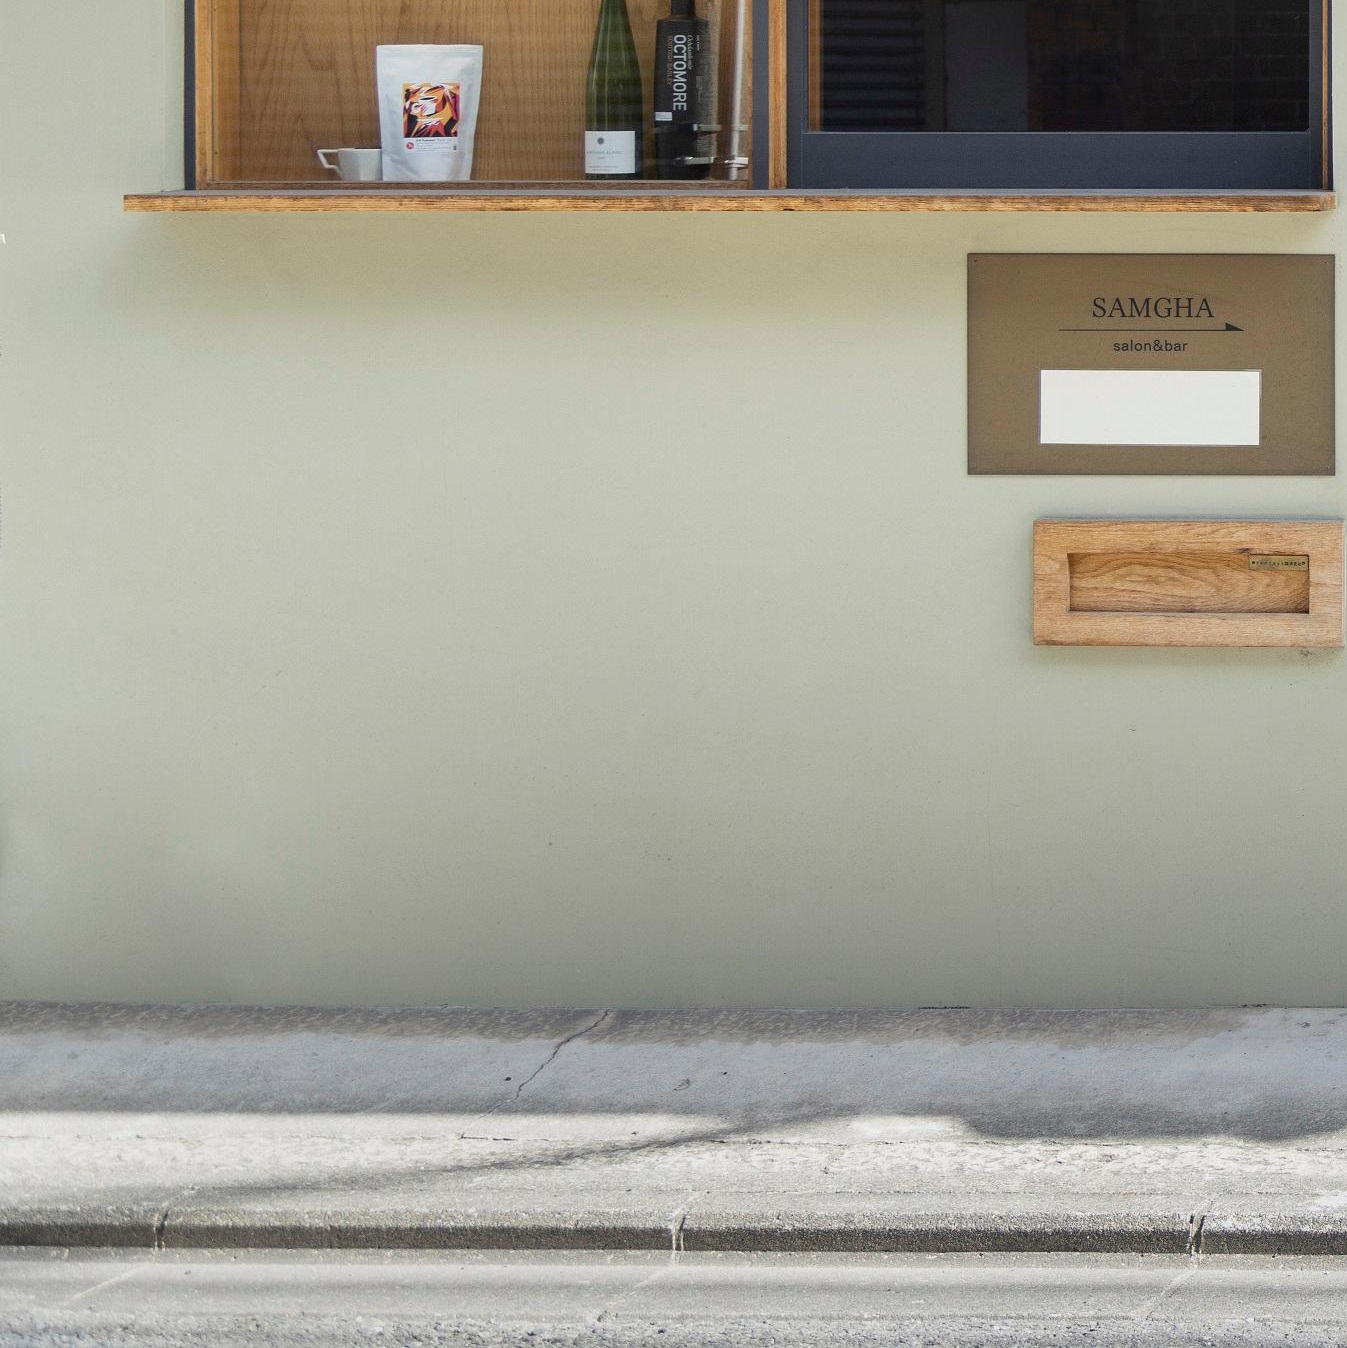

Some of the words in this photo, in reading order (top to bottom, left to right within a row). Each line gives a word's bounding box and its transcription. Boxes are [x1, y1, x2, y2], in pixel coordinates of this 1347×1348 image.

[673, 34, 687, 111] OCTOMORE
[1092, 297, 1215, 318] SAMGHA
[1113, 339, 1188, 352] salon&bar
